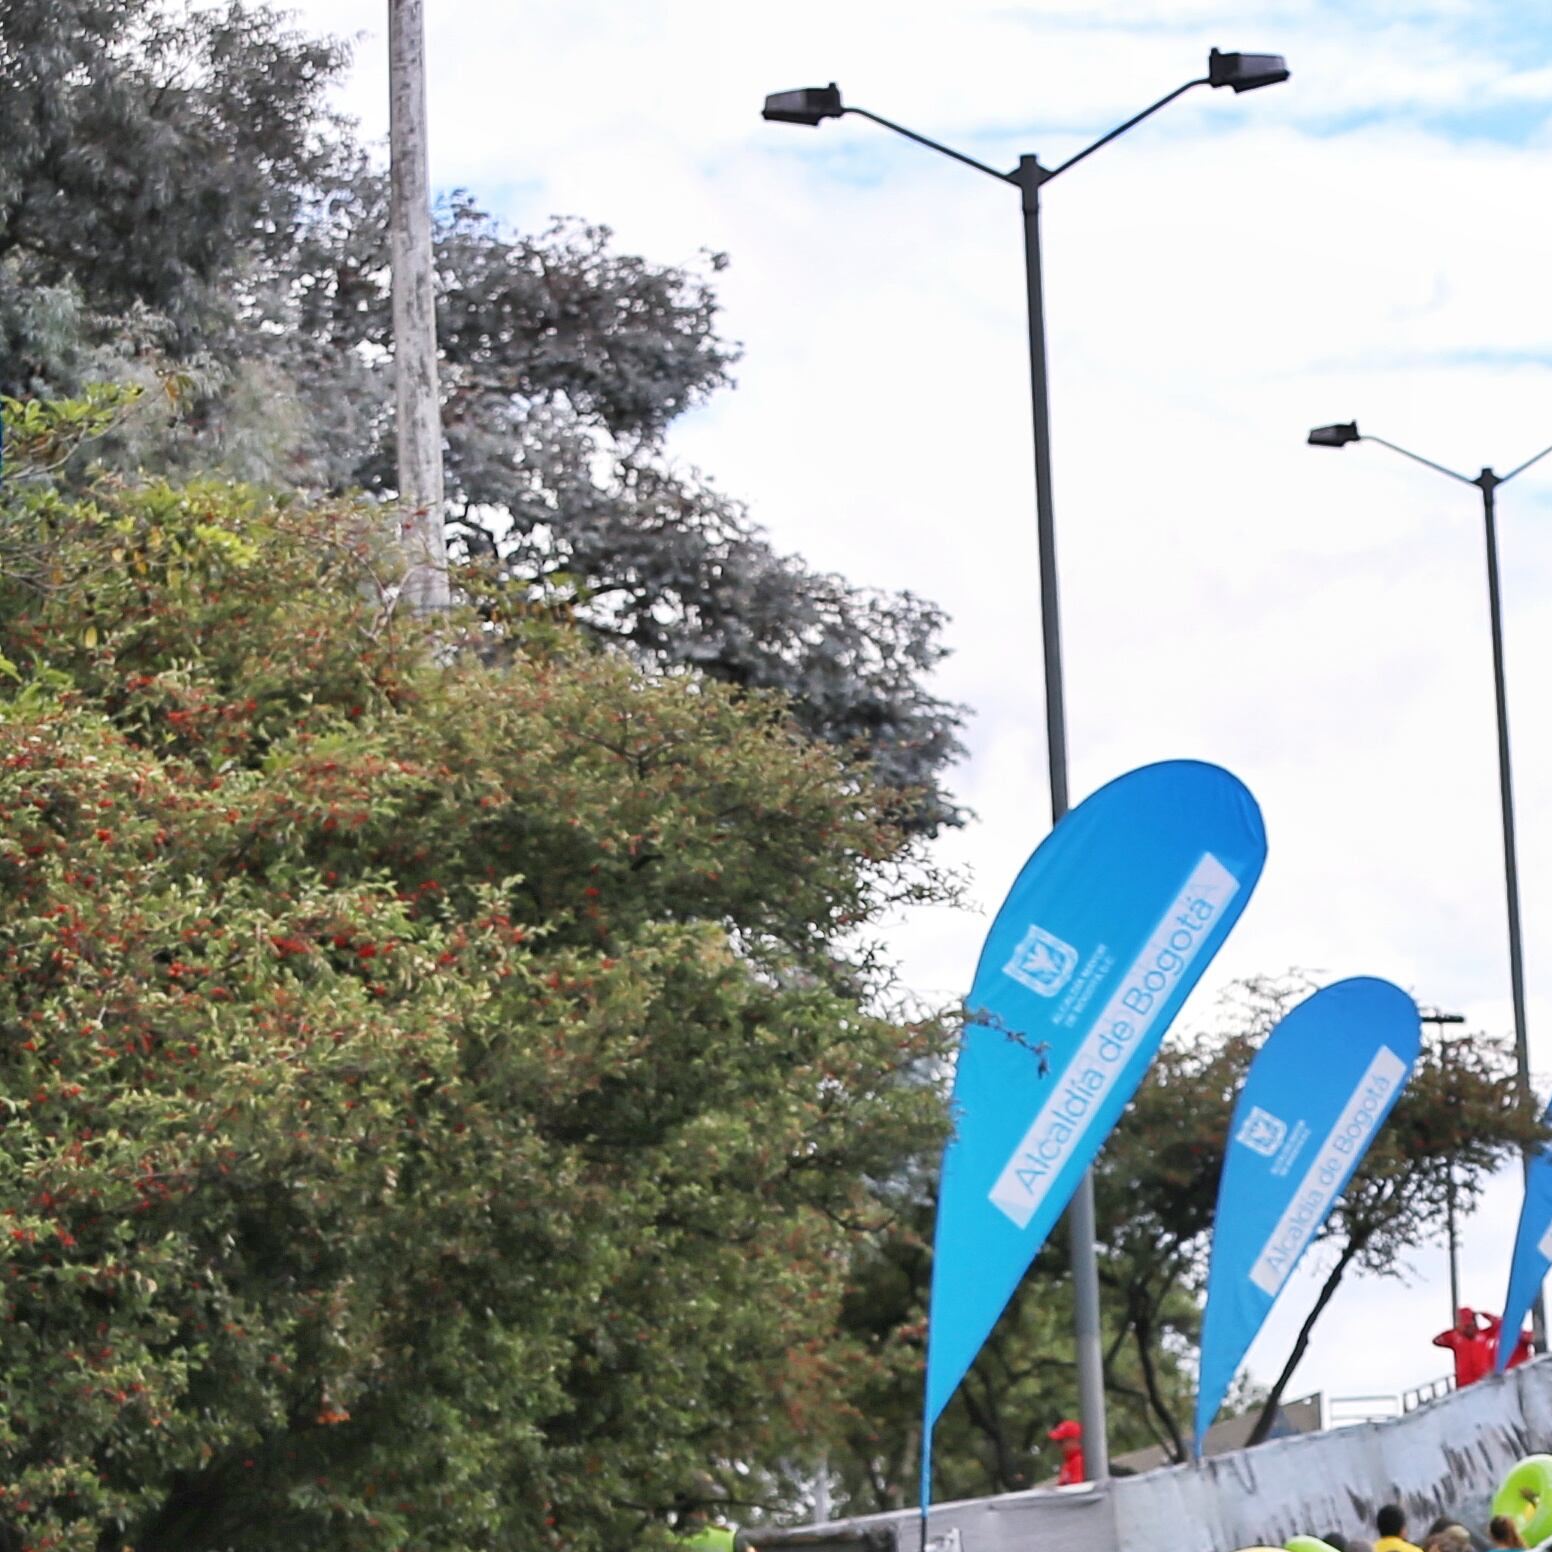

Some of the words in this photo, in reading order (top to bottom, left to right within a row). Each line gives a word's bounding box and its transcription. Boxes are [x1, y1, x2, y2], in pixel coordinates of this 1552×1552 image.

[1014, 1069, 1105, 1196] Alcaldía
[1099, 1018, 1136, 1064] de
[1122, 894, 1215, 1017] Bogotá
[1320, 1157, 1344, 1187] de
[1332, 1073, 1390, 1155] Bogotá
